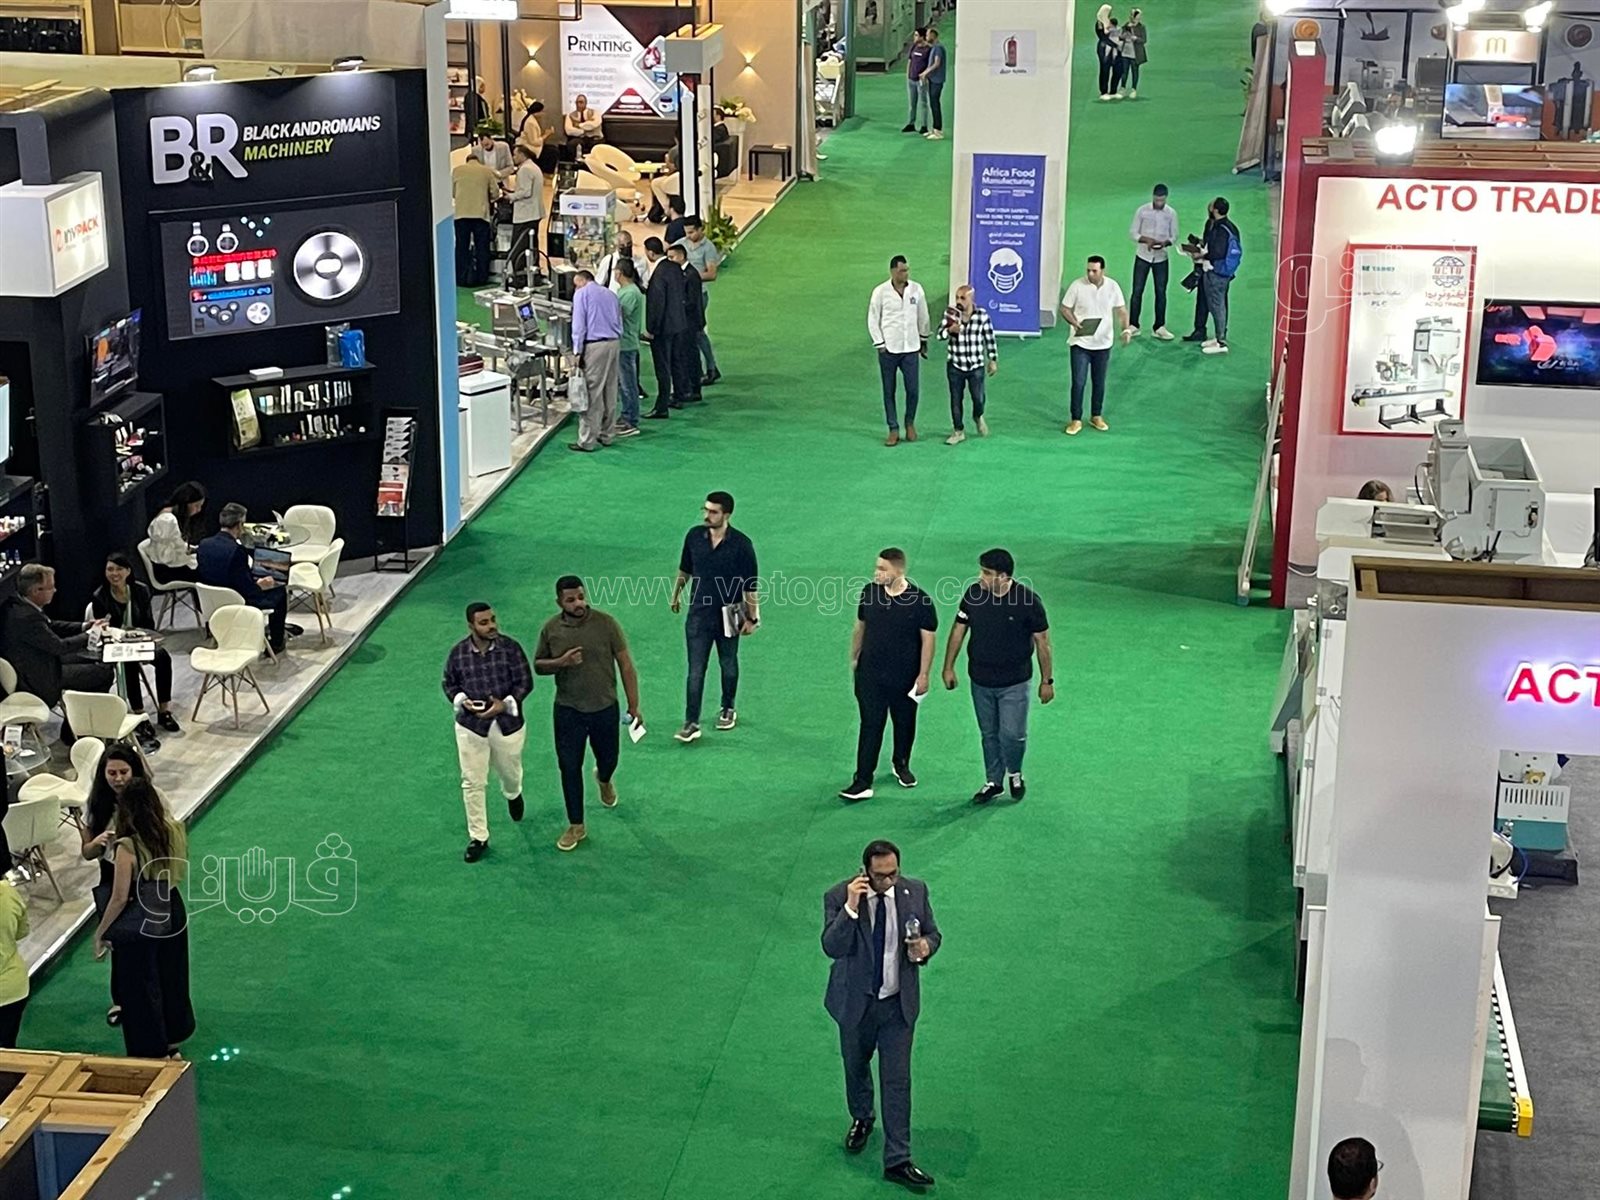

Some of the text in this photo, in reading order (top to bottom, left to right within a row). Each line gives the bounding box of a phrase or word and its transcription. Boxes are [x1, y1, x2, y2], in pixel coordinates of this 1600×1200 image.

[244, 137, 334, 161] MACHINERY
[982, 167, 1036, 178] Africa Food
[982, 177, 1036, 188] Manufacturing
[1376, 184, 1477, 212] ACTO
